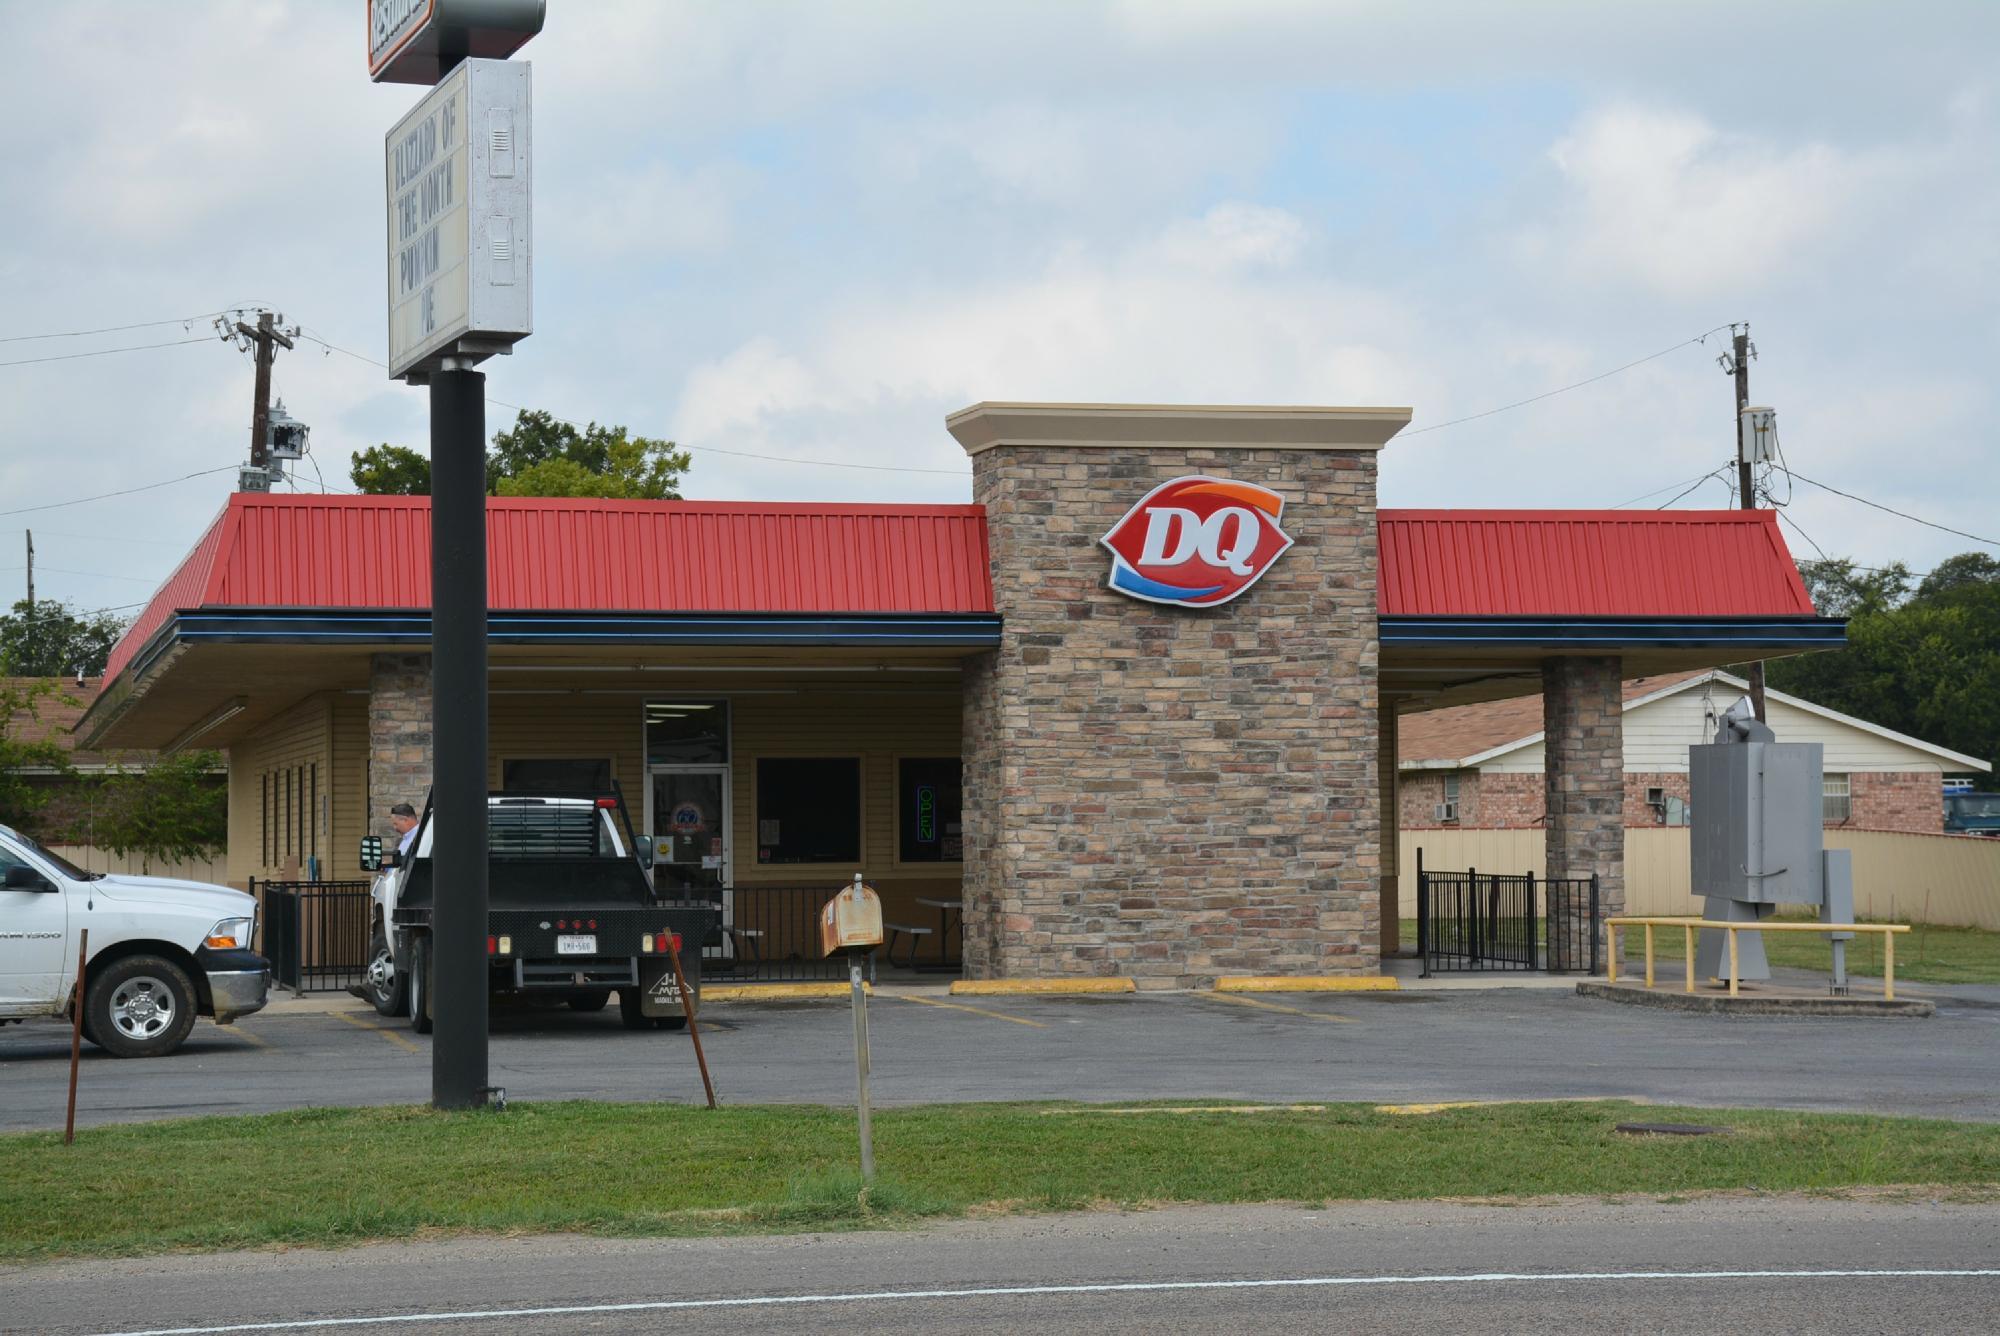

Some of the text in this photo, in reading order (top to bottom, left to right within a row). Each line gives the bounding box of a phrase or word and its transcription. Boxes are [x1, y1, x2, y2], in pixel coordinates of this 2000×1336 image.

[395, 96, 456, 192] BLIZZARD OF
[399, 157, 452, 241] THE MONTH
[401, 223, 439, 295] PUMPKIN
[422, 286, 435, 336] PIE
[1138, 507, 1260, 576] DQ
[920, 789, 933, 840] OPEN
[27, 931, 62, 939] 1500
